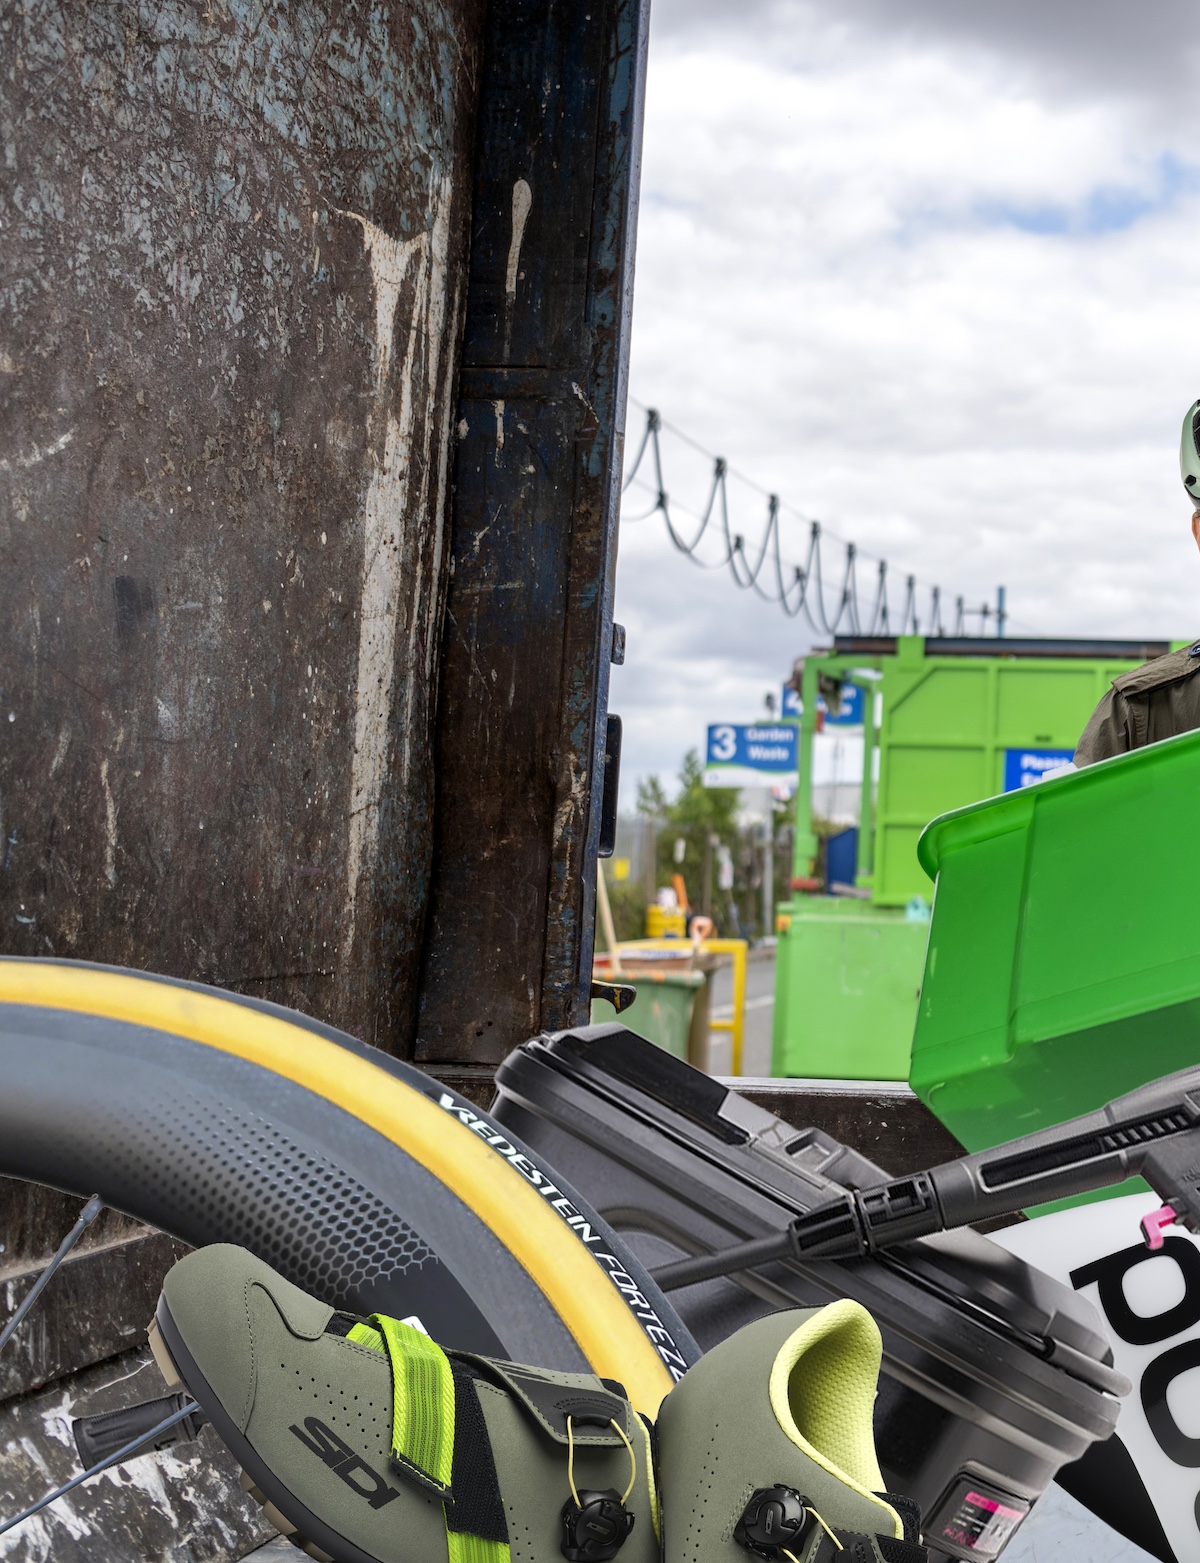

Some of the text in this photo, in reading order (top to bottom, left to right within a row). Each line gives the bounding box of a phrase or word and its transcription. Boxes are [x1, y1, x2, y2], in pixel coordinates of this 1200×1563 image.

[712, 726, 794, 760] 3 Garden
[748, 747, 790, 761] Waste
[439, 1093, 601, 1243] VREDESTEIN
